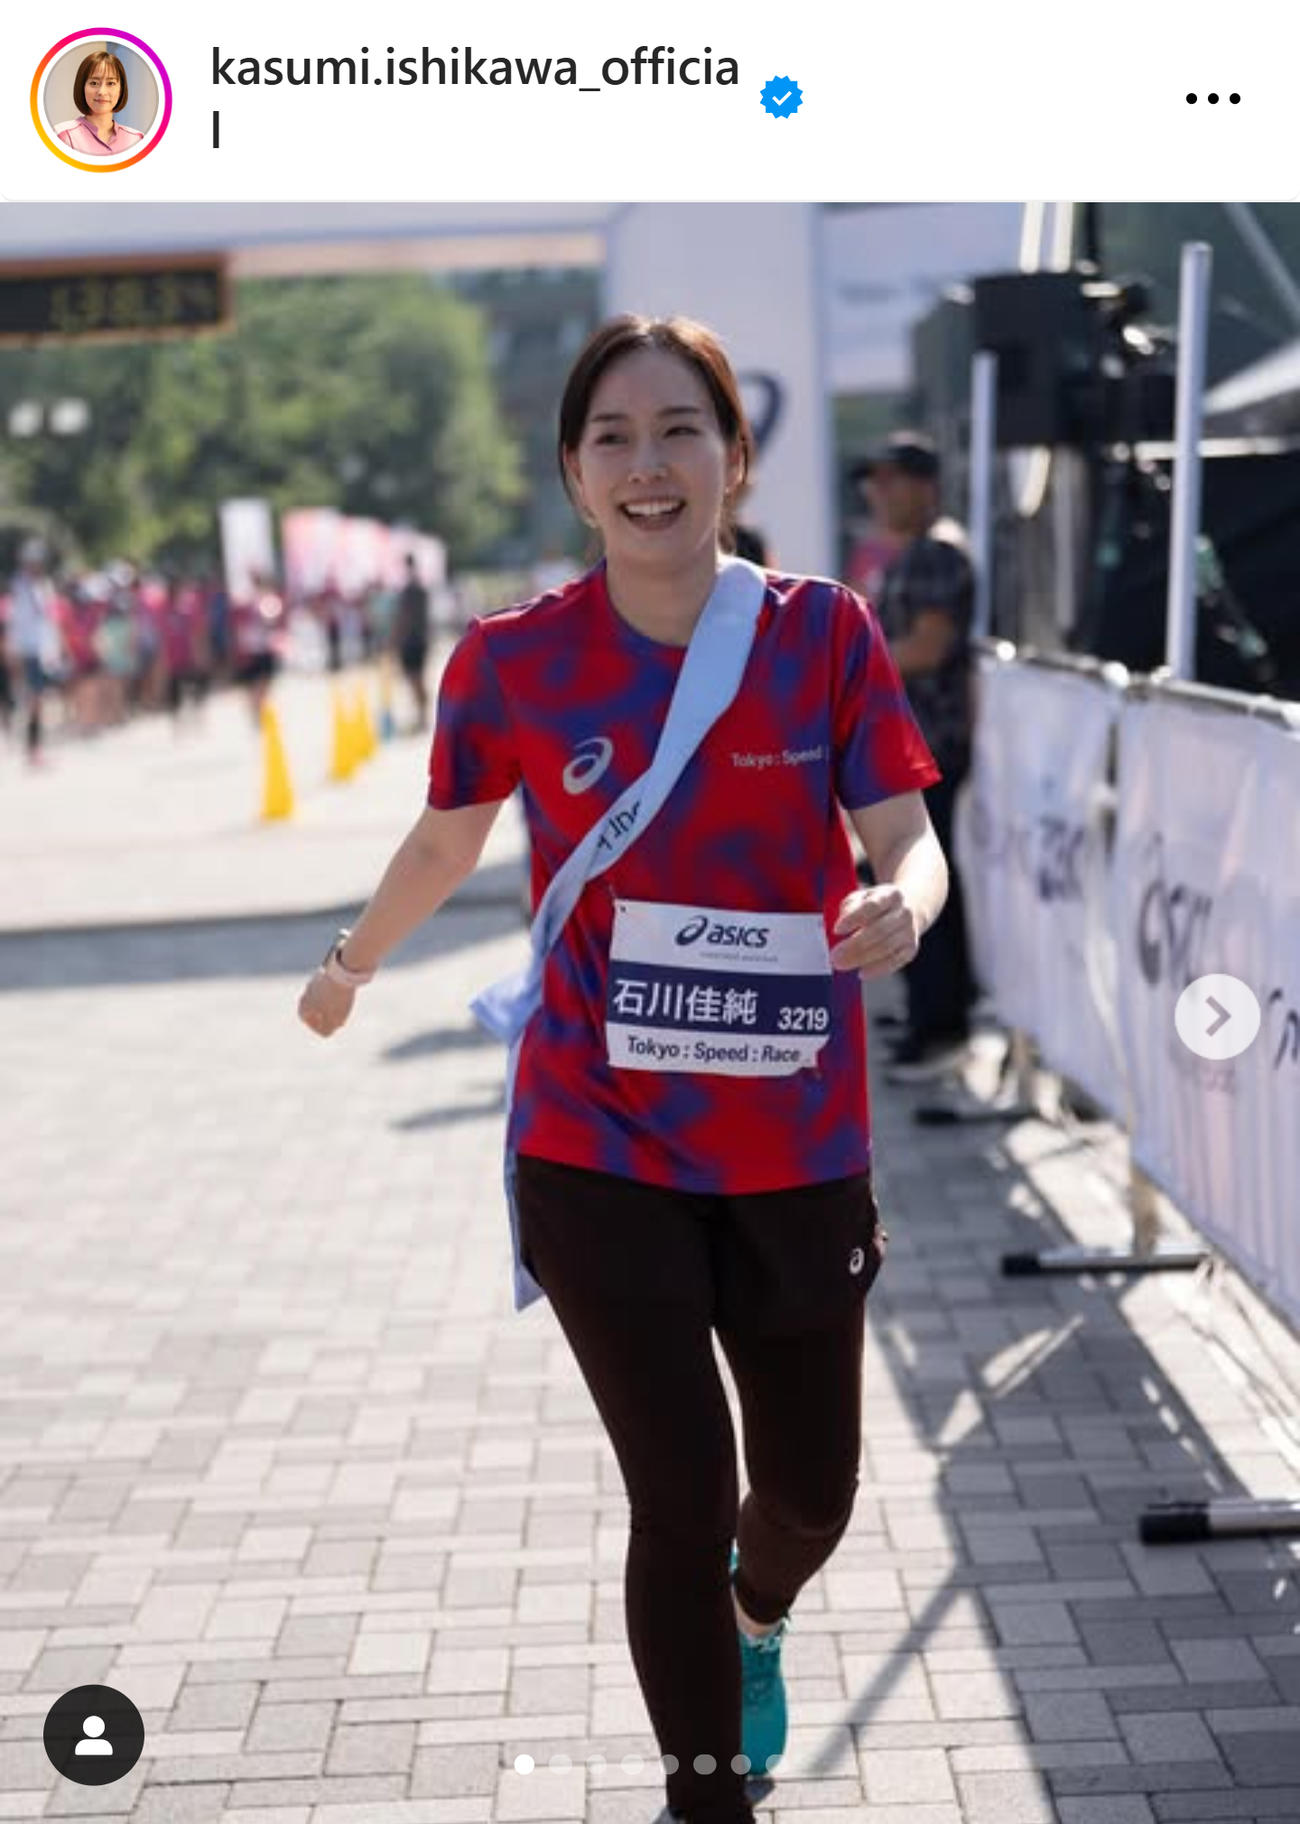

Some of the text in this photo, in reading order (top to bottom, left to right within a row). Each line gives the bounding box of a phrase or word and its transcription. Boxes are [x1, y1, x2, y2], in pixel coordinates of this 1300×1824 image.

[731, 752, 774, 771] Tokyo
[613, 978, 759, 1025] 石川佳純
[777, 1007, 829, 1031] 3219
[627, 1034, 680, 1061] Tokyo
[694, 1042, 748, 1063] Speed
[760, 1045, 801, 1063] Race
